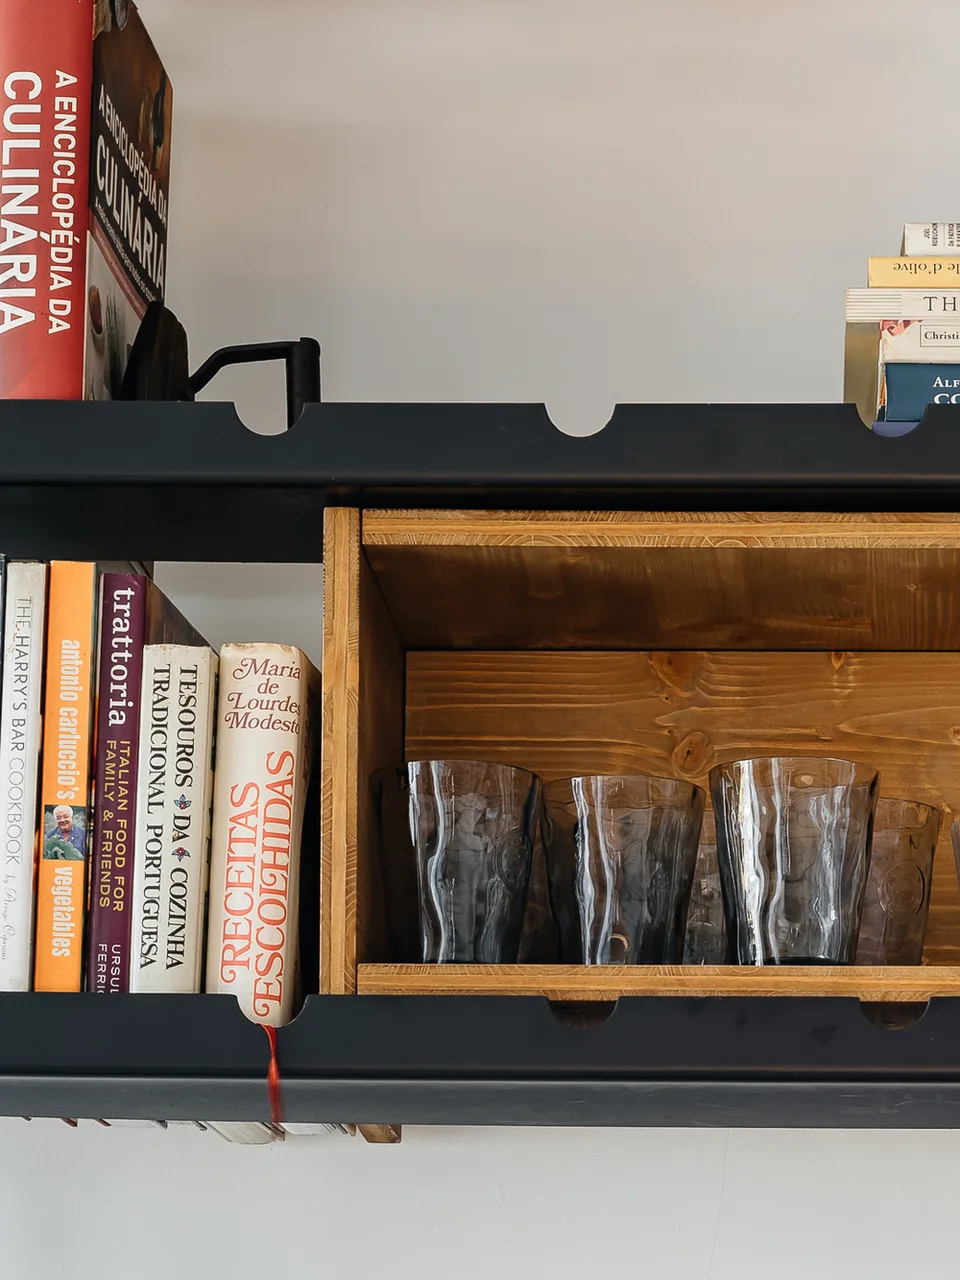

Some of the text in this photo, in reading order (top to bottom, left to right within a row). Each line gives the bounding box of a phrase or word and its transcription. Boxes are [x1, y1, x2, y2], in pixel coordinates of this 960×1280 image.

[0, 70, 52, 334] CULINÁRIA
[48, 69, 80, 335] A ENCICLOPÉDIA DA
[96, 134, 166, 301] CULINÁRIA
[98, 84, 105, 117] A
[105, 94, 159, 213] ENCICLOPÉDIA
[893, 261, 943, 274] d'olive
[6, 596, 33, 866] THE HARRY'S BAR COOKBOOK
[108, 587, 135, 728] trattoria
[224, 711, 301, 736] Modesto
[227, 691, 302, 717] Lourdes
[232, 657, 301, 681] Maria
[257, 679, 279, 695] de
[51, 638, 81, 959] antonio carluccio's vegetables
[98, 740, 117, 909] FAMILY & FRIENDS
[111, 740, 130, 912] ITALIAN FOOD FOR
[139, 664, 172, 971] TRADICIONAL PORTUGUESA
[165, 665, 199, 971] TESOUROS DA COZINHA
[221, 780, 261, 985] RECEITAS
[251, 750, 296, 1018] ESCOLHIDAS
